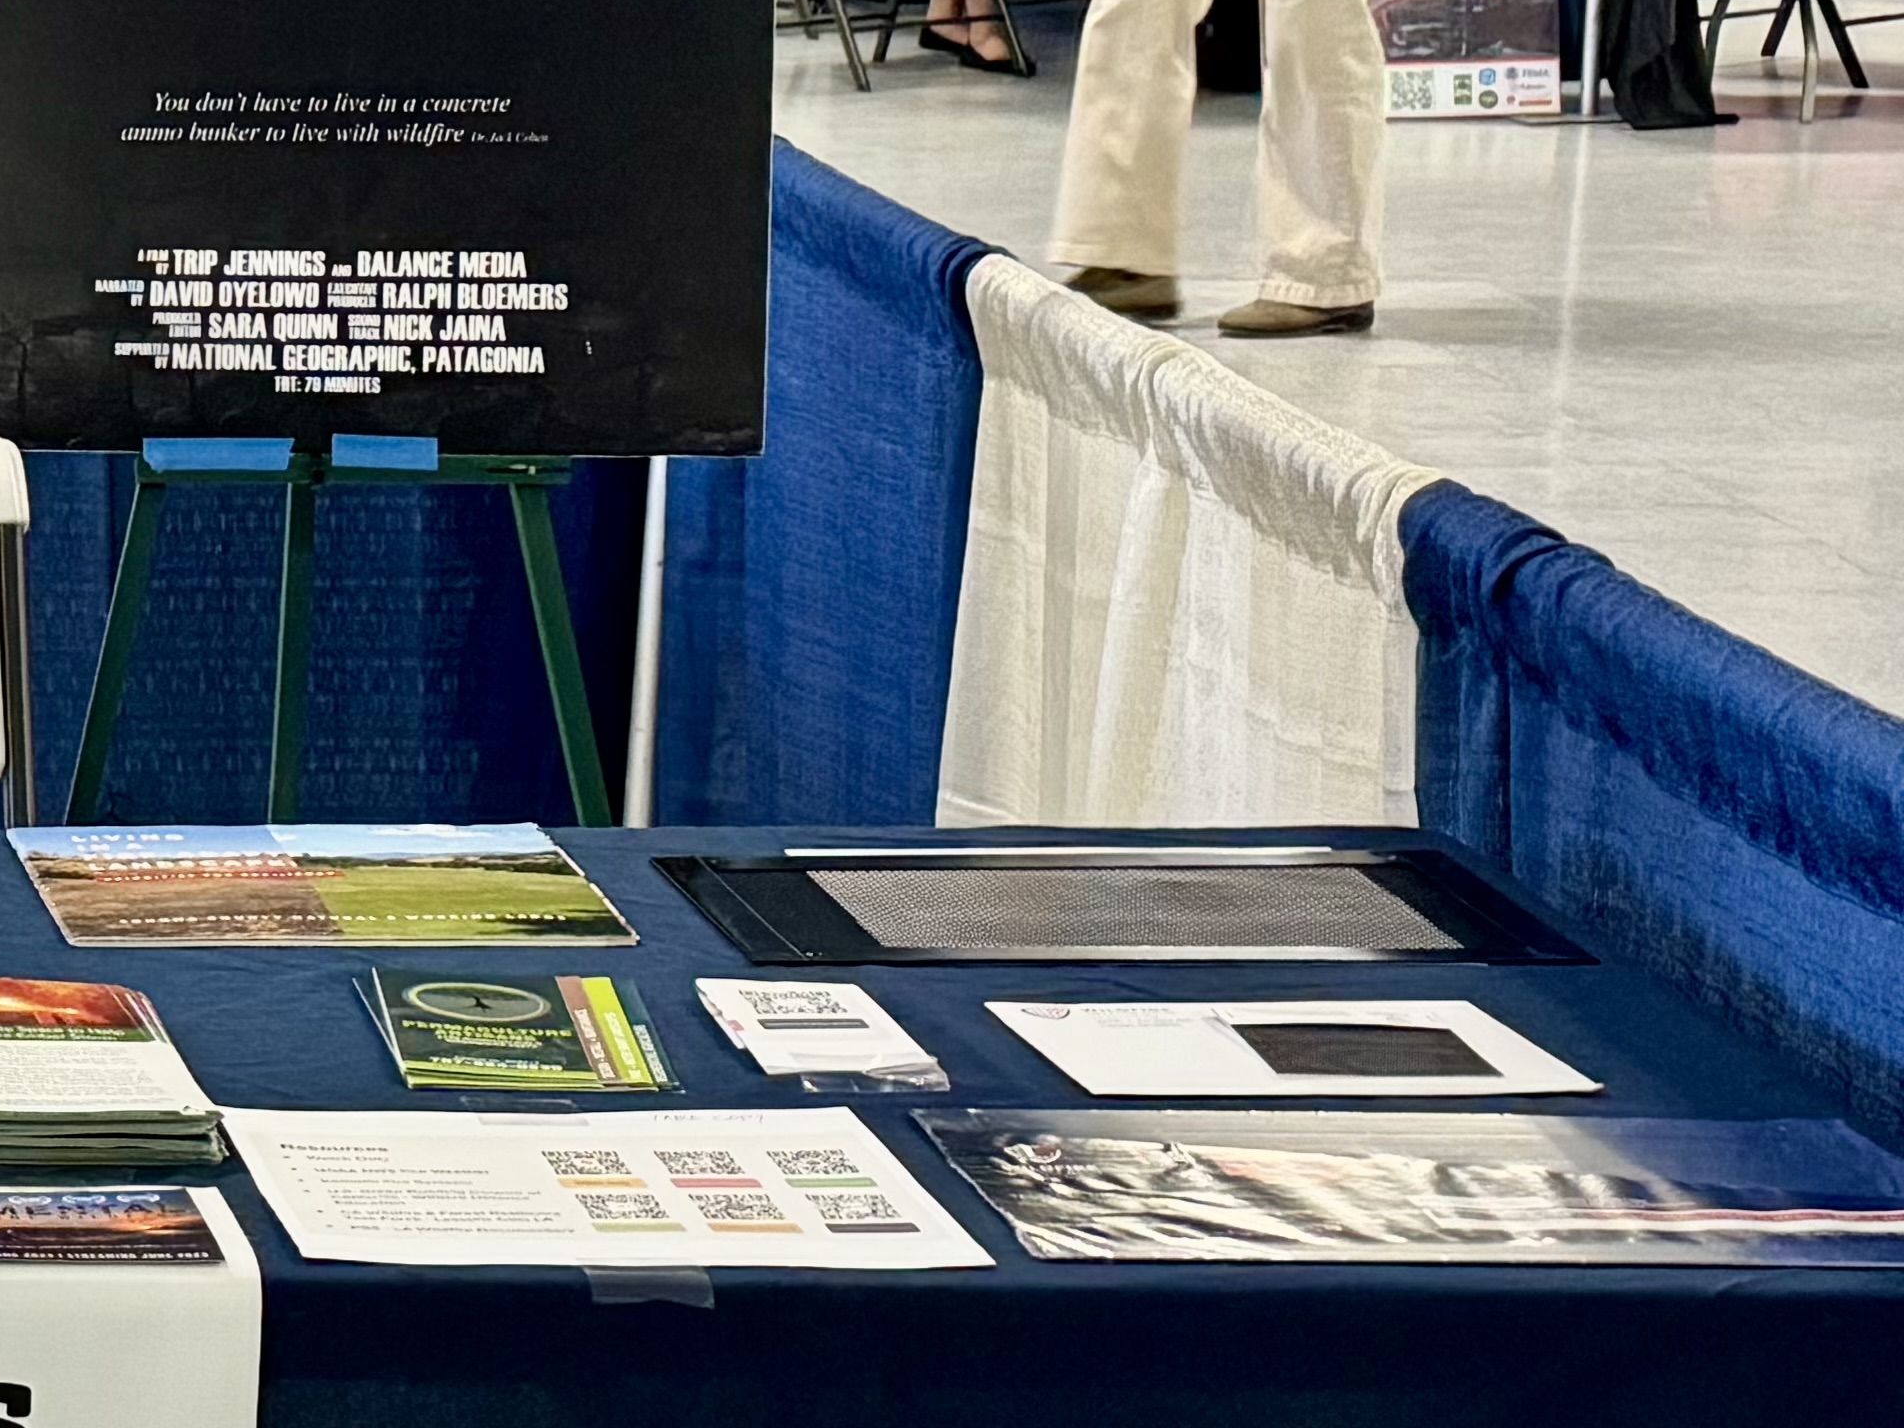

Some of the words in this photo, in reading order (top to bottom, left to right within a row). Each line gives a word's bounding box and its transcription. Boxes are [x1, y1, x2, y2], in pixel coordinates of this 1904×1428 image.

[155, 92, 189, 112] You
[195, 92, 249, 112] don't
[253, 92, 301, 112] have
[307, 94, 327, 112] to
[334, 91, 370, 112] live
[378, 93, 396, 112] in
[403, 98, 415, 112] a
[422, 95, 511, 112] concrete
[120, 126, 183, 142] ammo
[189, 122, 260, 142] bunker
[266, 125, 286, 142] to
[292, 122, 329, 142] live
[336, 122, 379, 142] with
[387, 122, 465, 146] wildfire
[173, 250, 218, 276] TRIP
[224, 251, 326, 277] JENNINGS
[358, 250, 453, 278] BALANCE
[459, 252, 527, 278] MEDIA
[150, 282, 214, 307] DAVID
[219, 283, 320, 308] OYELOWO
[383, 284, 452, 309] RALPH
[457, 283, 568, 310] BLOEMERS
[209, 313, 267, 339] SARA
[273, 314, 338, 342] QUINN
[384, 316, 432, 341] NICK
[440, 315, 506, 341] JAINA
[172, 344, 276, 371] NATIONAL
[283, 345, 417, 374] GEOGRAPHIC,
[422, 346, 545, 373] PATAGONIA
